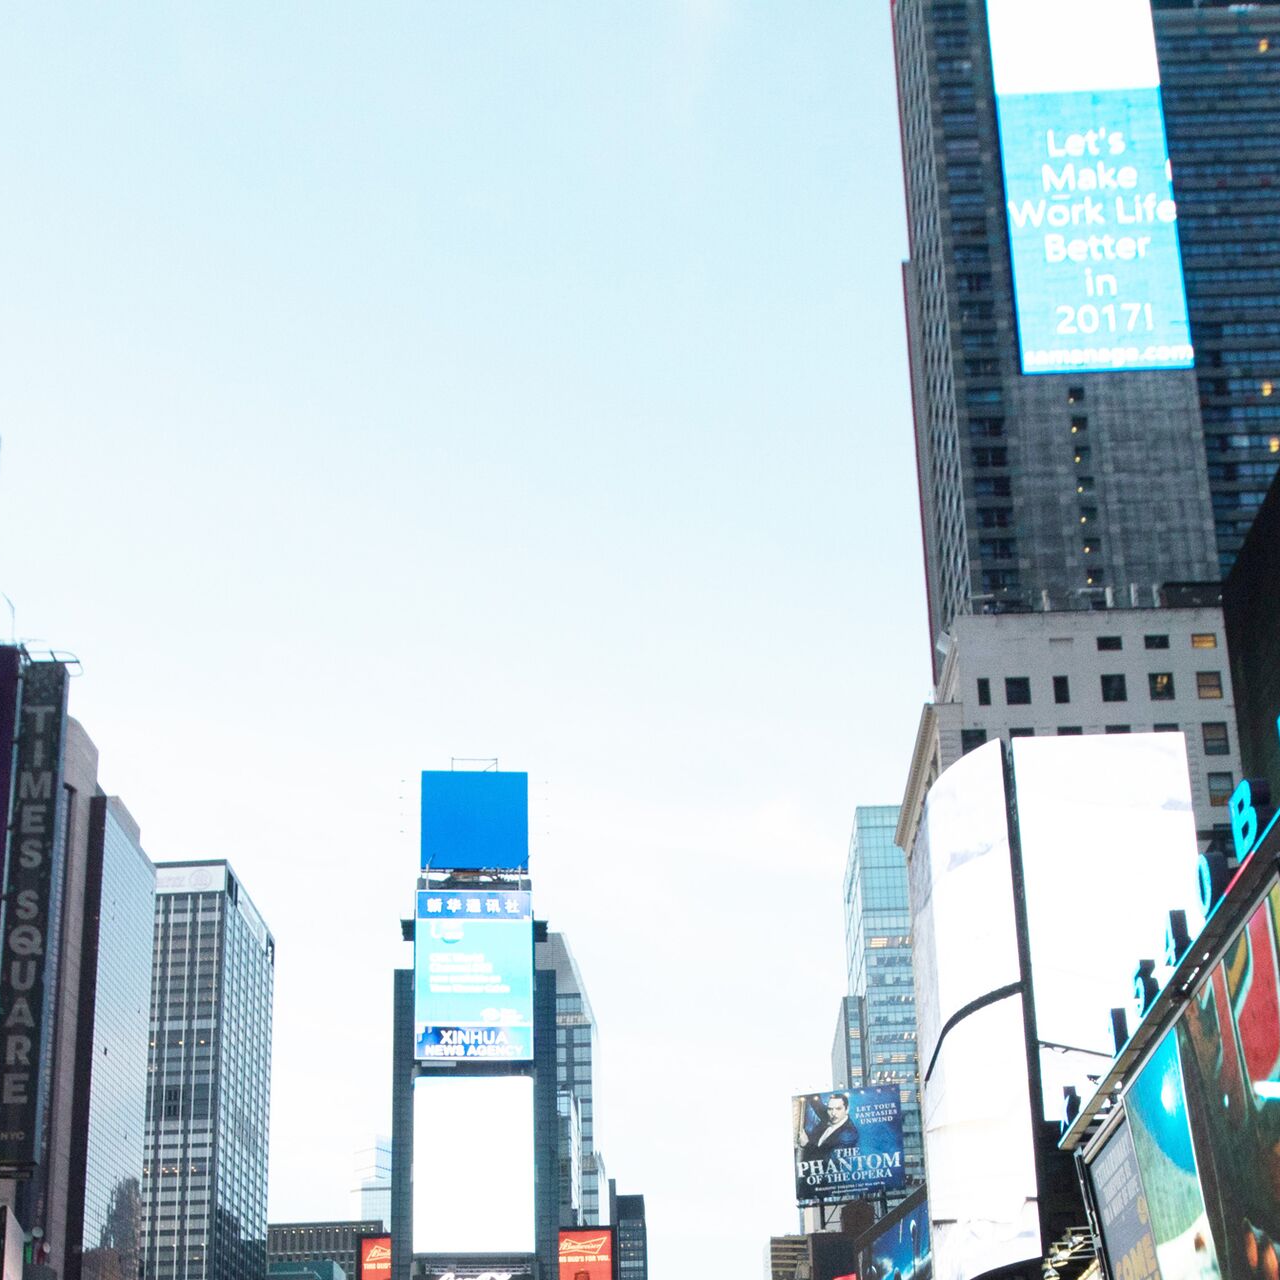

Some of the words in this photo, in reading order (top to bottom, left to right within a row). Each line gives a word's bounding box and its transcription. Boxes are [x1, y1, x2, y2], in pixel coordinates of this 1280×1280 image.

[1046, 127, 1126, 157] Let's
[1041, 162, 1138, 191] Make
[1009, 196, 1105, 229] Work
[1116, 193, 1177, 225] Life
[1045, 232, 1151, 264] Better
[1085, 267, 1117, 298] in
[1055, 302, 1155, 335] 2017!
[20, 704, 57, 868] TIMES
[3, 889, 44, 1105] SQUARE
[424, 1044, 466, 1057] NEWS
[467, 1044, 524, 1056] AGENCY
[439, 1030, 508, 1045] XINHUA
[855, 1108, 898, 1119] FANTASIES
[856, 1104, 872, 1113] LET
[876, 1102, 897, 1111] YOUR
[860, 1115, 894, 1125] UNWIND
[796, 1151, 902, 1178] PHANTOM
[834, 1147, 860, 1158] THE
[806, 1174, 825, 1186] OF
[827, 1171, 850, 1184] THE
[851, 1168, 893, 1181] OPERA
